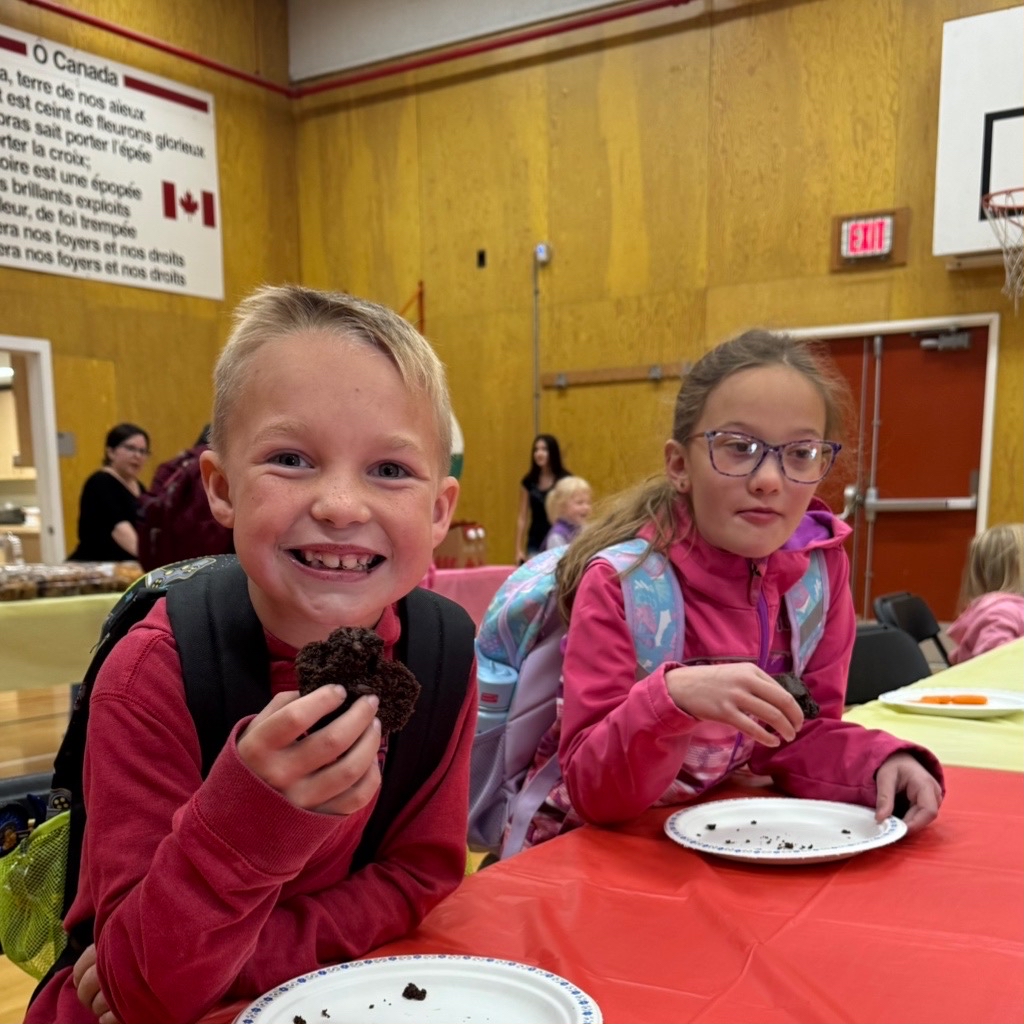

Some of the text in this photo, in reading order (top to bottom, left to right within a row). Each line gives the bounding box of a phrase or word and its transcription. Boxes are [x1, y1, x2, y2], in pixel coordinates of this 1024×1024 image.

[53, 50, 119, 87] Canada
[16, 70, 53, 95] terre
[56, 83, 75, 101] de
[78, 92, 106, 110] nos
[6, 92, 31, 111] est
[75, 110, 93, 127] de
[31, 140, 46, 158] la
[65, 131, 108, 151] porter
[33, 164, 56, 182] est
[60, 170, 88, 189] une
[11, 178, 73, 206] brillants
[75, 195, 131, 218] exploits
[35, 205, 55, 223] de
[57, 209, 78, 228] foi
[23, 226, 52, 244] nos
[56, 230, 101, 252] foyers
[103, 241, 119, 255] et
[120, 245, 146, 260] nos
[149, 249, 186, 268] droits
[849, 220, 885, 254] EXIT
[25, 247, 54, 265] nos
[57, 251, 102, 273] foyers
[104, 260, 120, 276] et
[121, 264, 148, 280] nos
[150, 265, 187, 287] droits
